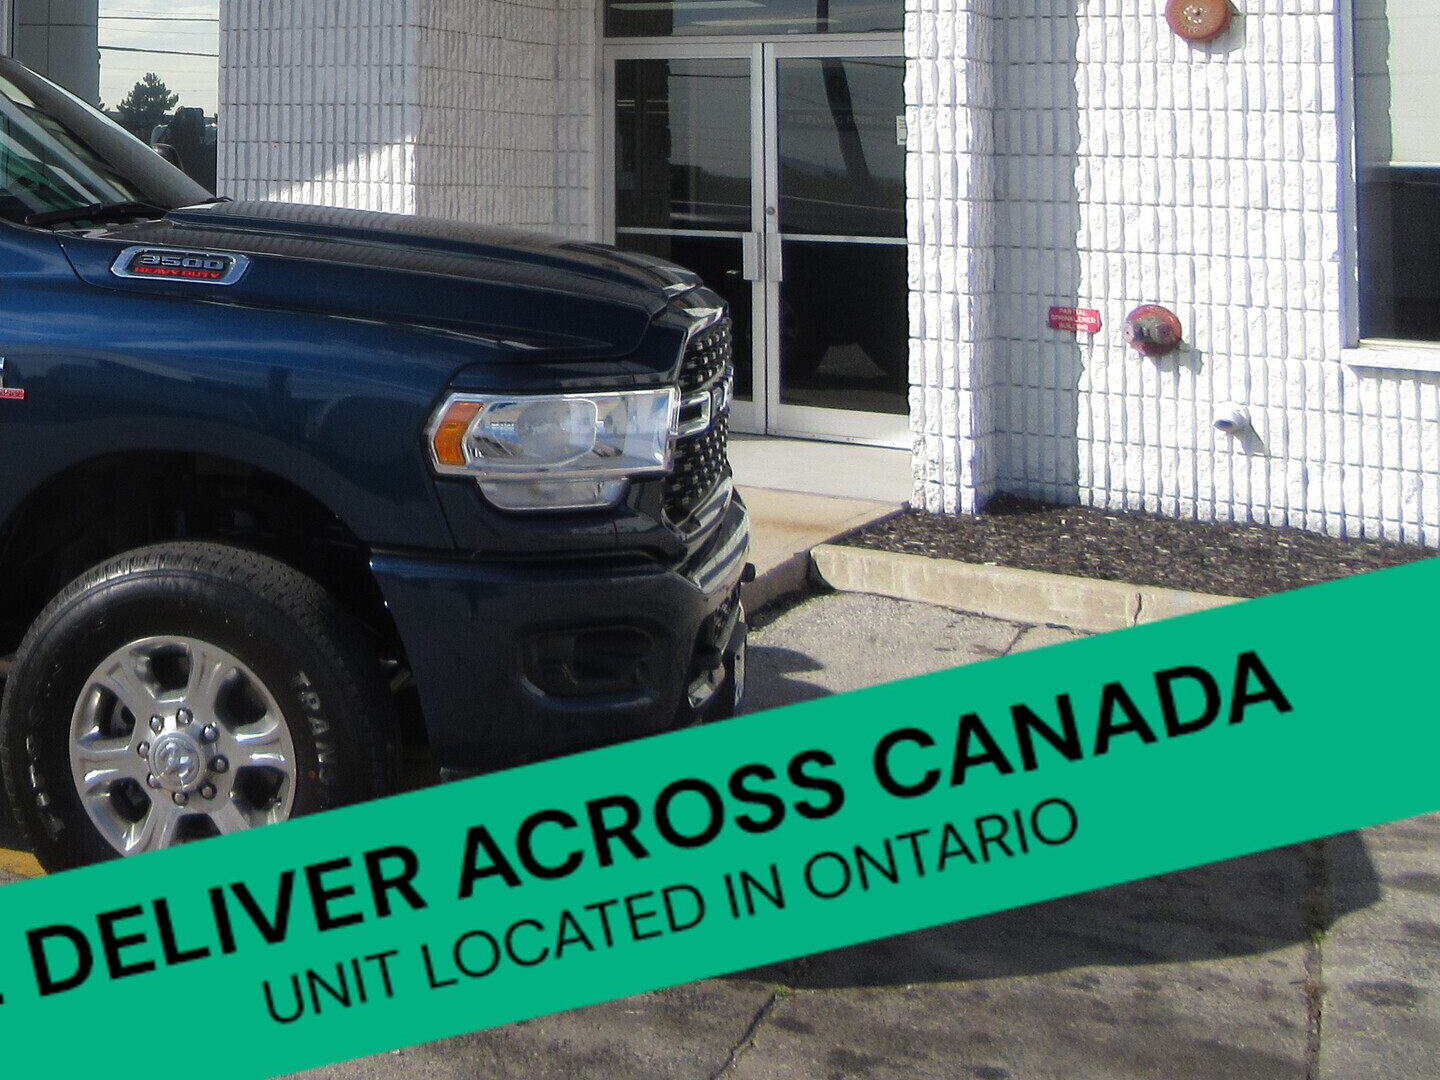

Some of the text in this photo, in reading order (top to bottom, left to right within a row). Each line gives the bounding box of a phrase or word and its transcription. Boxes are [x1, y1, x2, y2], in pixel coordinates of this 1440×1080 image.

[139, 254, 225, 270] 3500
[134, 266, 221, 279] HEAVY DUTY
